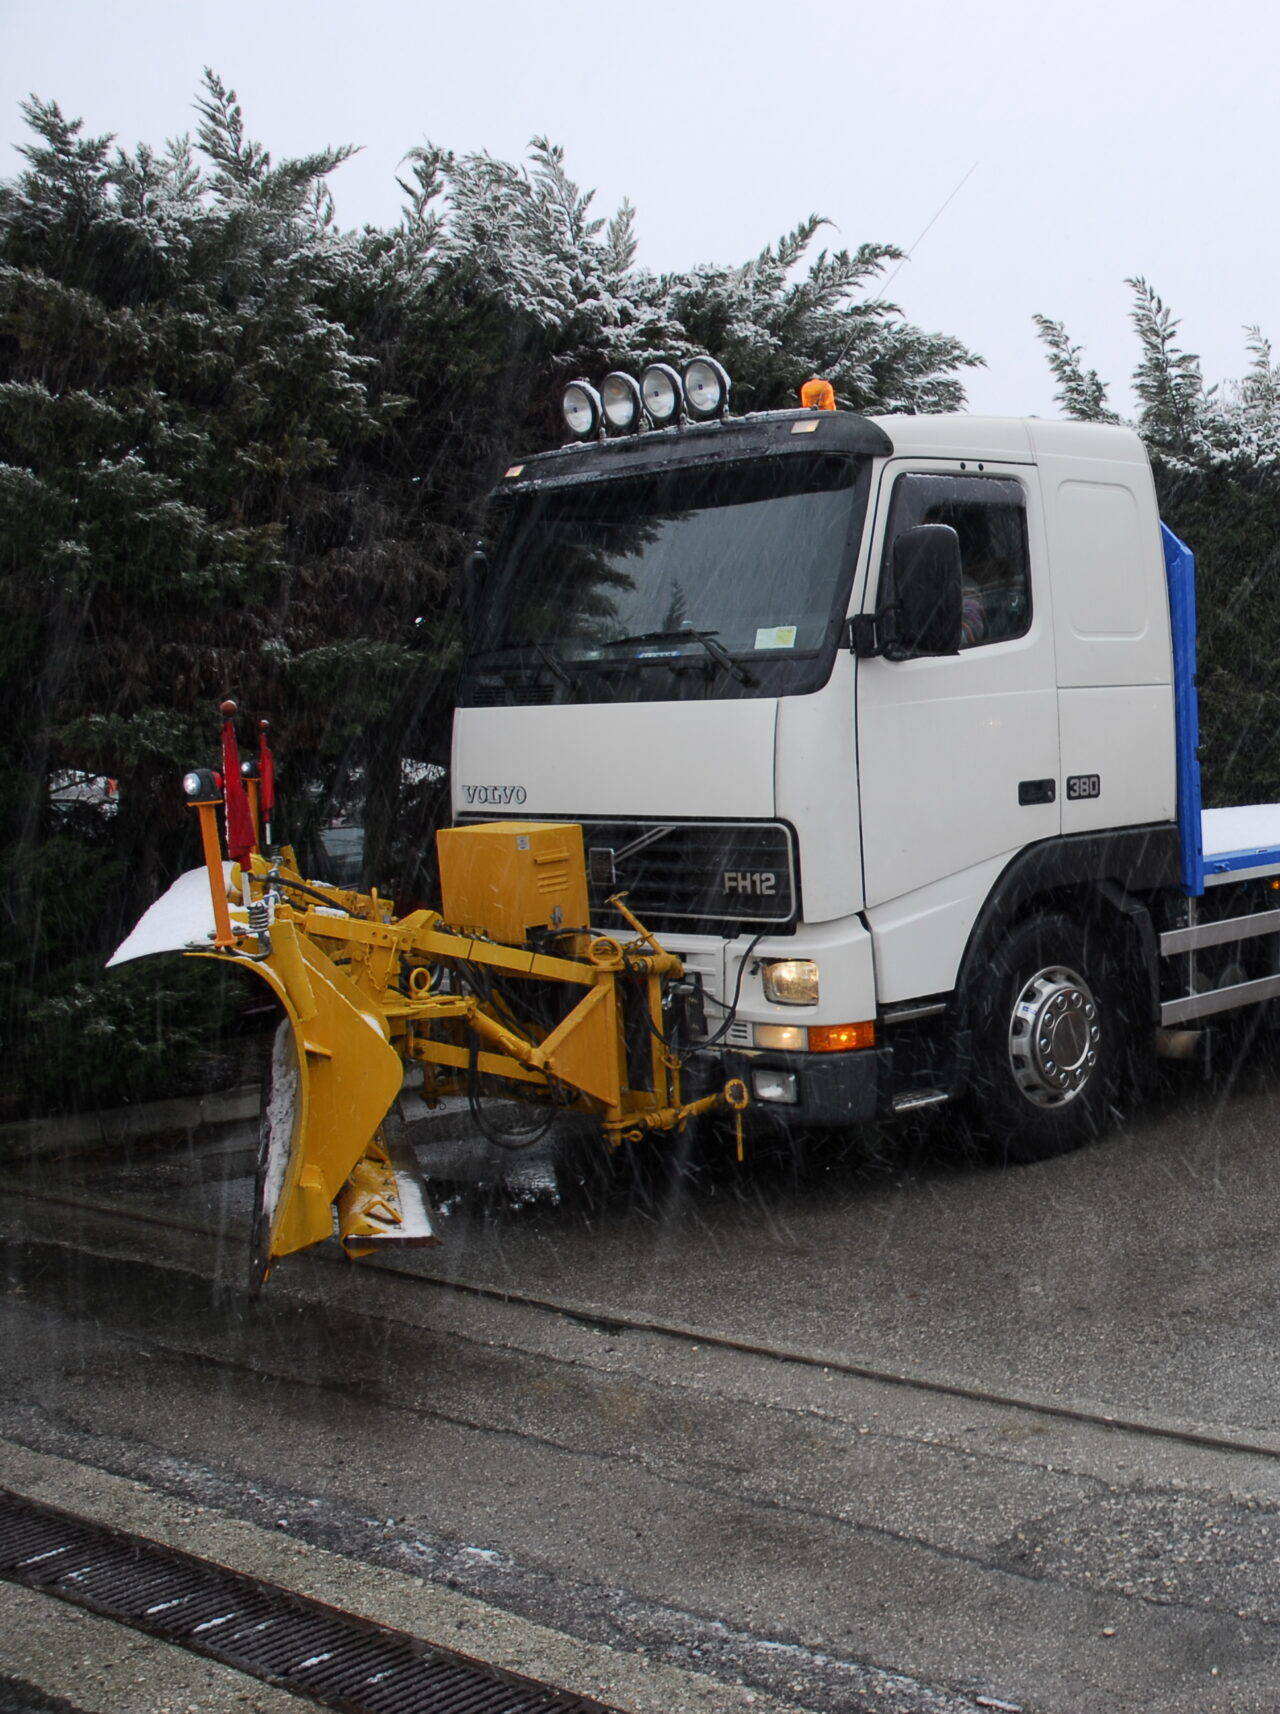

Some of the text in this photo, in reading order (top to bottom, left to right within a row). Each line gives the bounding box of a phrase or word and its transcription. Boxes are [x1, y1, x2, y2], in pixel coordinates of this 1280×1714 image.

[462, 785, 527, 804] VOLVO
[1070, 776, 1099, 797] 380
[723, 872, 776, 894] FH12
